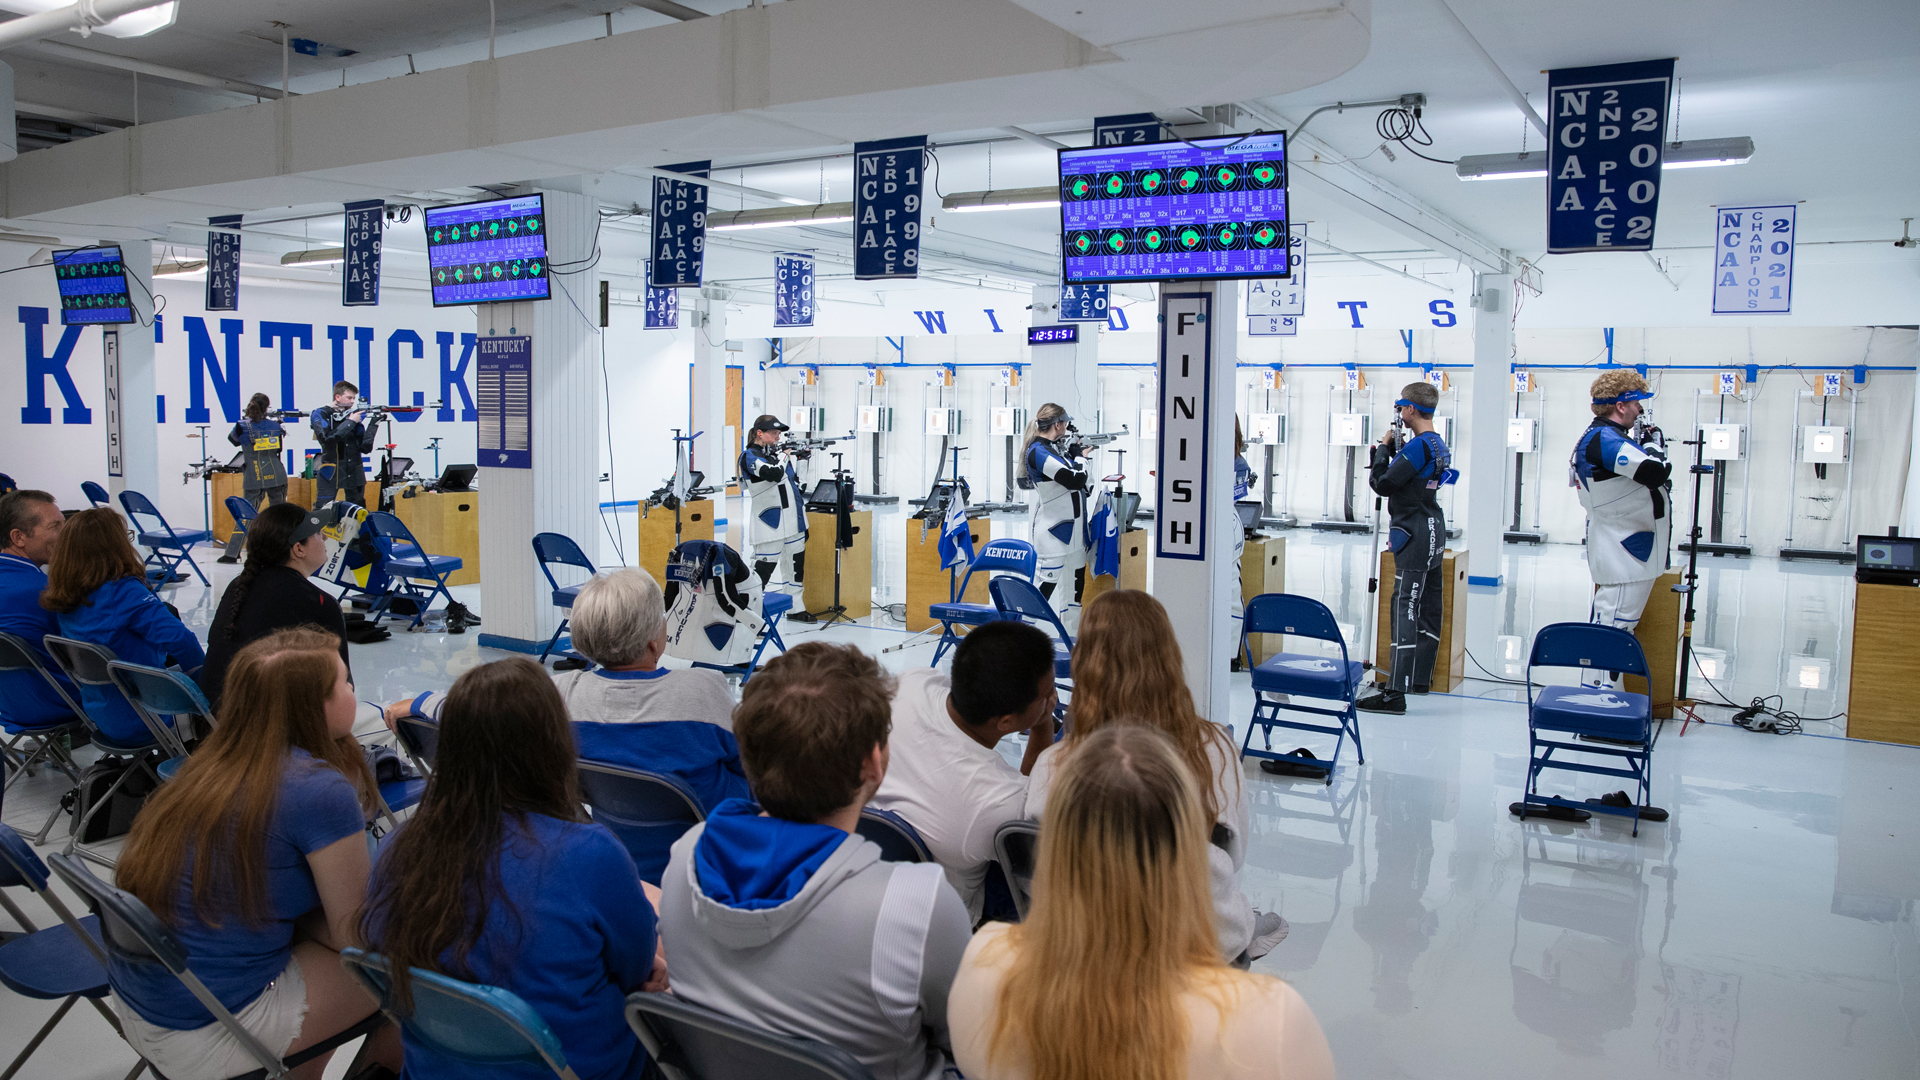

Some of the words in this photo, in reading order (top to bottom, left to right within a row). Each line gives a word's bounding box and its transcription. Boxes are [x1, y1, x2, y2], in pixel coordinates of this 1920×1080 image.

[1599, 90, 1621, 140] 2ND
[884, 156, 897, 194] 3RD
[1556, 91, 1590, 211] NCAA
[1626, 107, 1658, 240] 2002
[361, 212, 370, 240] 3RD
[659, 178, 673, 261] NCAA
[692, 188, 706, 277] 1997
[860, 157, 879, 248] NCAA
[903, 167, 920, 268] 1998
[1594, 161, 1618, 246] PLACE
[212, 232, 222, 288] NCAA
[349, 214, 360, 282] NCAA
[676, 224, 687, 283] PLACE
[883, 209, 897, 274] PLACE
[1288, 236, 1302, 304] 2011
[1719, 212, 1743, 286] NCAA
[1748, 212, 1763, 308] CHAMPIONS
[1768, 218, 1790, 300] 2021
[362, 252, 370, 300] PLACE
[778, 257, 788, 308] NCAA
[802, 260, 812, 317] 2009
[1081, 284, 1090, 317] LACE
[18, 306, 477, 424] KNTUCK
[482, 340, 525, 353] KENTUCKY
[108, 342, 119, 469] FINISH
[1170, 312, 1196, 544] FINISH
[985, 547, 1028, 560] KENTUCKY
[1428, 517, 1436, 556] BRADEN
[675, 594, 697, 645] KENTUCKY
